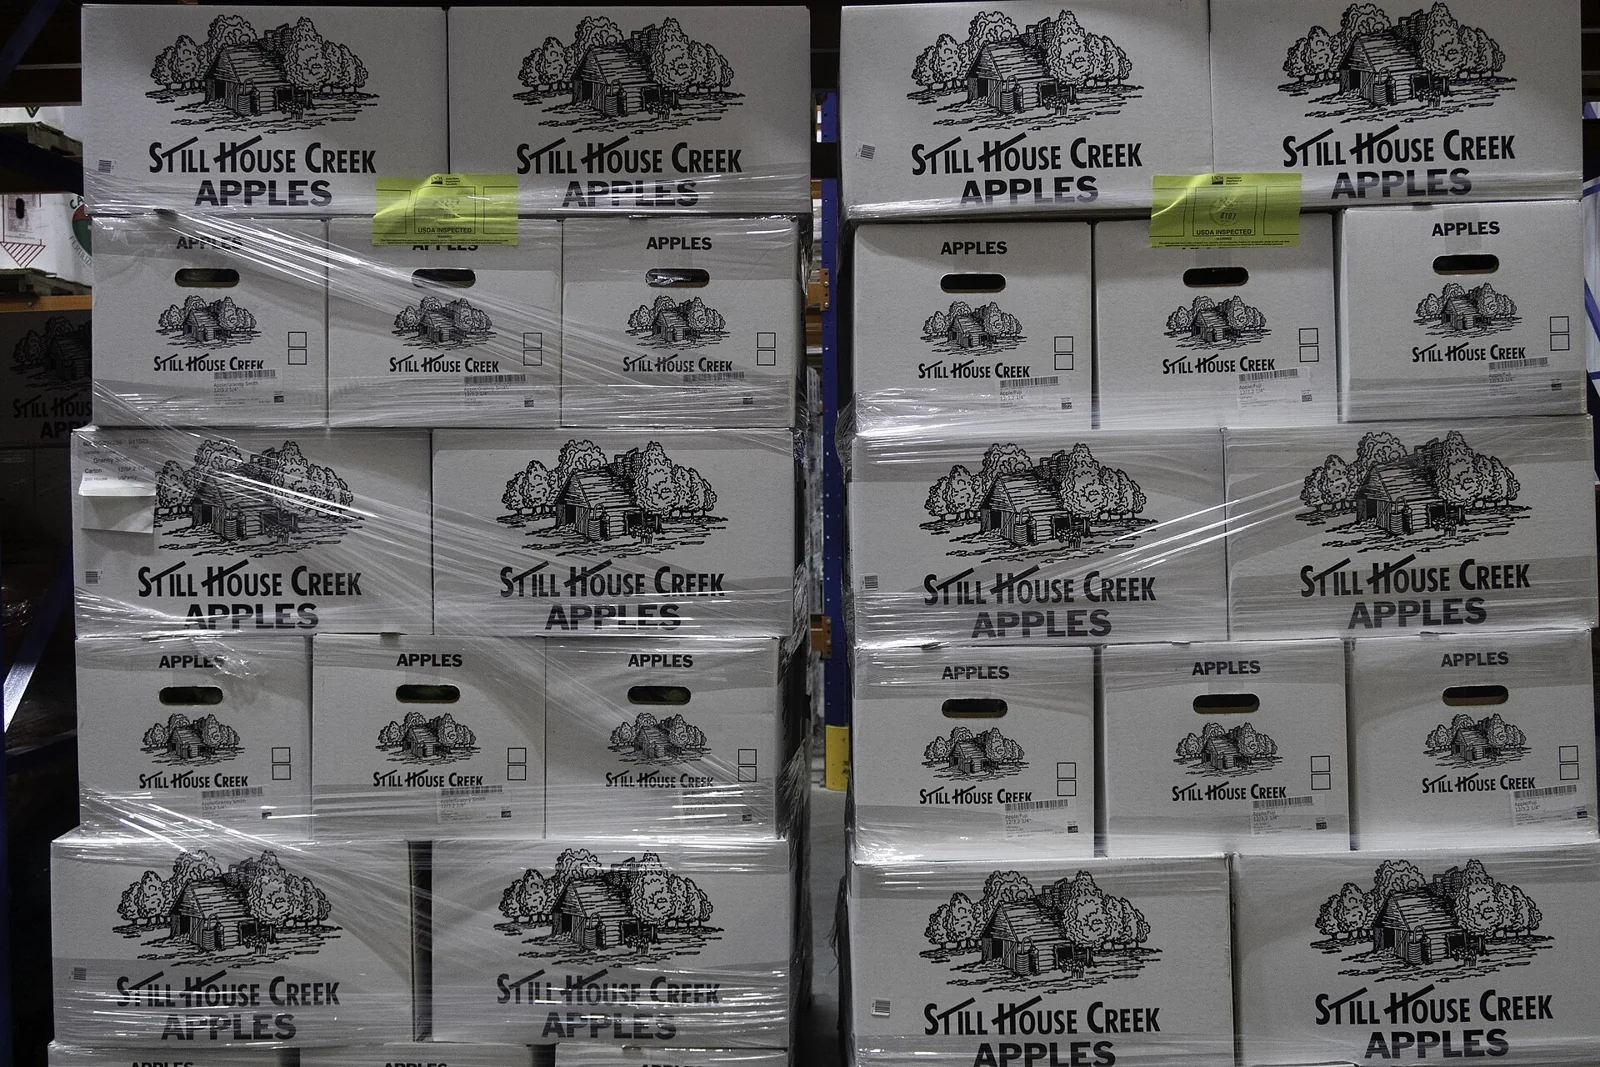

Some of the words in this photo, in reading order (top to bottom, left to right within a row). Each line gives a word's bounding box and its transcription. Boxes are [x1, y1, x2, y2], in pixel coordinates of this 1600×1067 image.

[149, 137, 209, 173] STILL
[213, 135, 295, 173] HOUSE
[305, 142, 376, 173] CREEK
[517, 137, 577, 174] STILL
[580, 135, 662, 173] HOUSE
[672, 142, 742, 173] CREEK
[912, 136, 974, 175] STILL
[977, 132, 1061, 172] HOUSE
[1071, 137, 1142, 168] CREEK
[1283, 128, 1346, 167] STILL
[1349, 124, 1434, 164] HOUSE
[1444, 129, 1515, 161] CREEK
[195, 180, 332, 206] APPLES
[563, 180, 698, 207] APPLES
[963, 176, 1098, 205] APPLES
[1331, 168, 1472, 199] APPLES
[70, 195, 84, 208] CA
[1432, 221, 1500, 236] APPLES
[646, 237, 712, 250] APPLES
[941, 241, 1007, 255] APPLES
[154, 354, 184, 371] STILL
[185, 353, 225, 371] HOUSE
[230, 357, 263, 370] CREEK
[390, 355, 419, 372] STILL
[421, 354, 460, 372] HOUSE
[465, 358, 499, 372] CREEK
[623, 355, 653, 372] STILL
[654, 354, 694, 372] HOUSE
[699, 357, 732, 372] CREEK
[1163, 356, 1193, 374] STILL
[1195, 354, 1235, 373] HOUSE
[1240, 356, 1275, 371] CREEK
[1412, 344, 1443, 362] STILL
[1445, 342, 1486, 361] HOUSE
[1490, 344, 1525, 360] CREEK
[919, 360, 948, 378] STILL
[950, 360, 990, 378] HOUSE
[995, 363, 1030, 378] CREEK
[13, 394, 48, 418] STILL
[50, 392, 92, 418] HOUS
[138, 561, 197, 597] STILL
[201, 559, 282, 596] HOUSE
[291, 566, 362, 596] CREEK
[500, 561, 560, 597] STILL
[564, 559, 645, 597] HOUSE
[654, 566, 725, 597] CREEK
[924, 568, 986, 606] STILL
[990, 565, 1074, 604] HOUSE
[1084, 571, 1156, 602] CREEK
[1300, 558, 1363, 597] STILL
[1366, 554, 1450, 594] HOUSE
[1459, 559, 1530, 590] CREEK
[186, 603, 318, 629] APPLES
[545, 604, 681, 630] APPLES
[972, 609, 1111, 638] APPLES
[1348, 597, 1487, 629] APPLES
[396, 654, 462, 667] APPLES
[628, 654, 693, 668] APPLES
[1192, 660, 1260, 675] APPLES
[1441, 651, 1509, 667] APPLES
[942, 666, 1009, 679] APPLES
[139, 771, 169, 789] STILL
[170, 770, 210, 788] HOUSE
[214, 773, 248, 787] CREEK
[373, 770, 403, 787] STILL
[404, 769, 444, 787] HOUSE
[449, 773, 483, 789] CREEK
[606, 770, 635, 787] STILL
[636, 770, 676, 788] HOUSE
[680, 773, 714, 788] CREEK
[1172, 783, 1203, 801] STILL
[1205, 781, 1246, 800] HOUSE
[1251, 784, 1286, 799] CREEK
[1422, 775, 1453, 793] STILL
[1454, 773, 1496, 792] HOUSE
[1500, 775, 1535, 790] CREEK
[920, 786, 950, 804] STILL
[952, 785, 992, 804] HOUSE
[997, 789, 1032, 804] CREEK
[117, 971, 176, 1007] STILL
[180, 970, 260, 1007] HOUSE
[269, 976, 339, 1006] CREEK
[497, 969, 555, 1004] STILL
[559, 969, 640, 1006] HOUSE
[650, 976, 720, 1003] CREEK
[924, 998, 988, 1035] STILL
[992, 995, 1077, 1035] HOUSE
[1087, 1001, 1161, 1033] CREEK
[1315, 987, 1380, 1025] STILL
[1384, 984, 1470, 1024] HOUSE
[1480, 990, 1553, 1021] CREEK
[161, 1014, 296, 1040] APPLES
[542, 1012, 677, 1040] APPLES
[974, 1041, 1115, 1067] APPLES
[1365, 1029, 1508, 1058] APPLES
